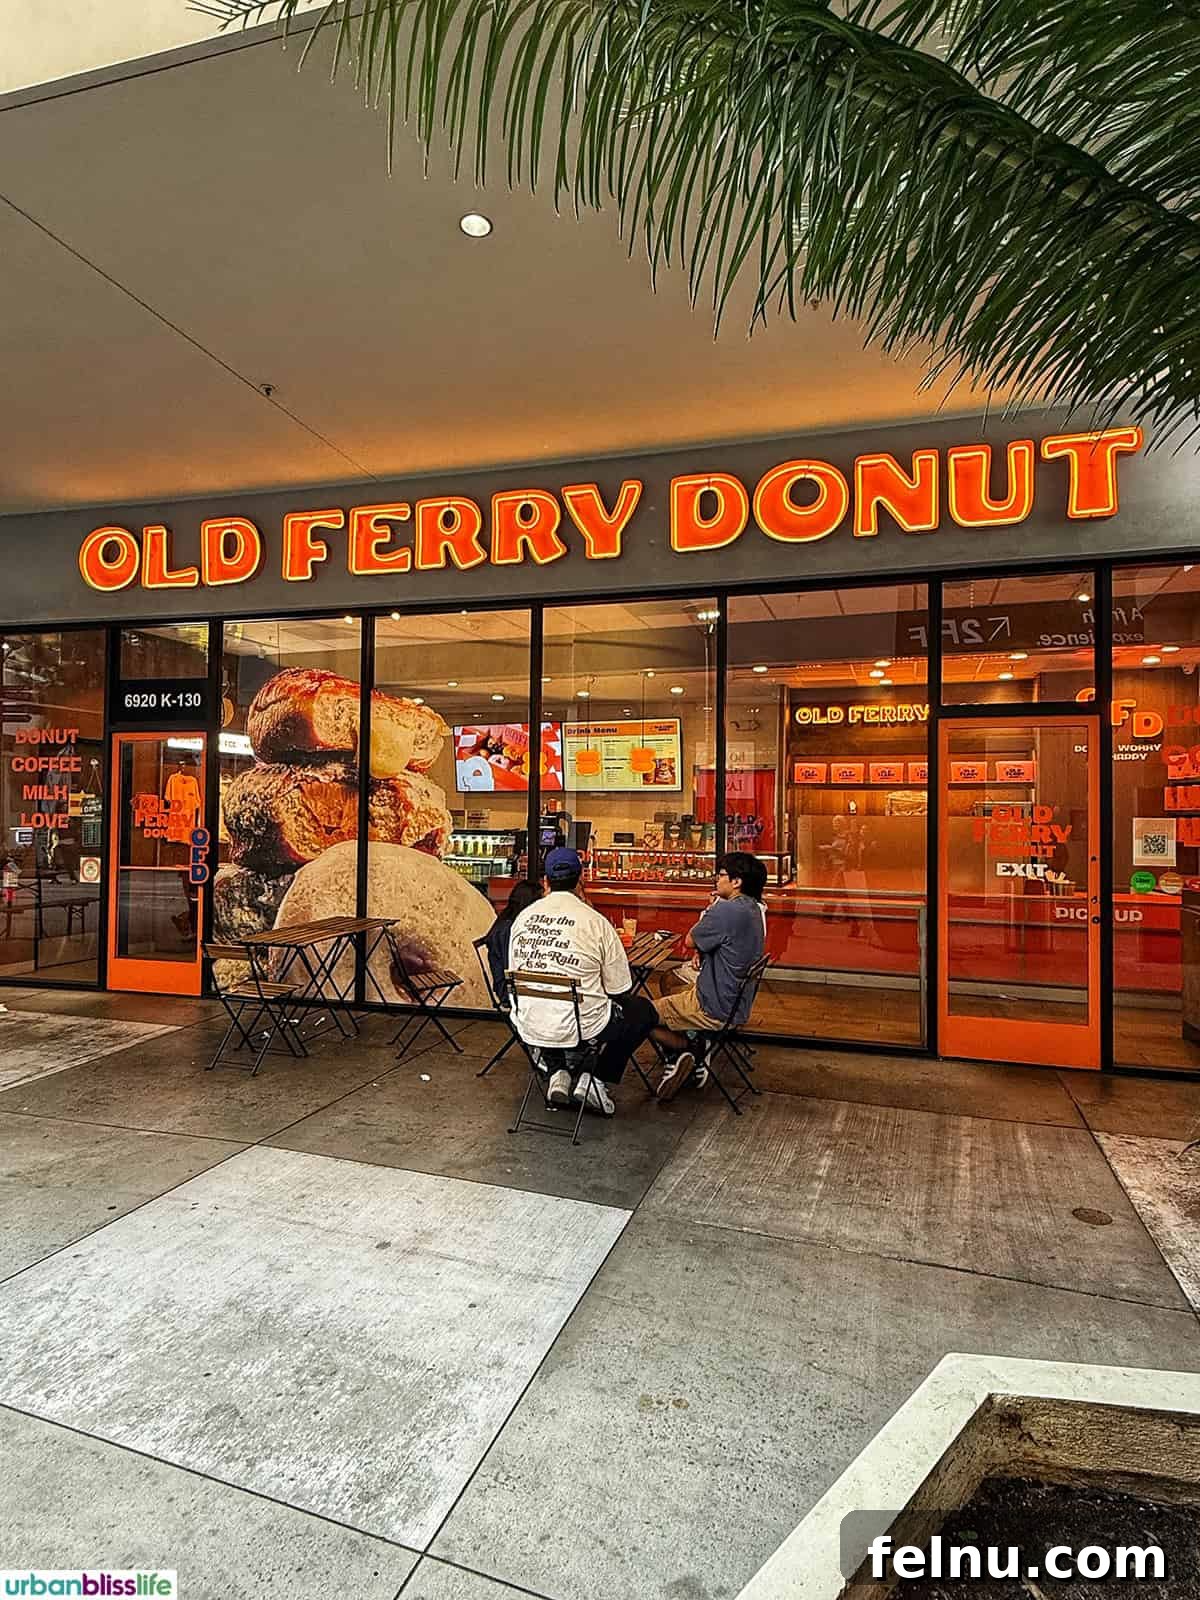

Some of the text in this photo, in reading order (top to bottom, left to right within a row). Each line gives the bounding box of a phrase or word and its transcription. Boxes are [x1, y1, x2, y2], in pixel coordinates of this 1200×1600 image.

[79, 427, 1143, 592] OLD FERRY DONUT
[124, 692, 202, 708] 6920 K-130
[795, 703, 930, 725] OLD FERRY
[15, 728, 79, 744] DONUT
[567, 727, 592, 735] Drink
[11, 756, 82, 773] COFFEE
[21, 812, 71, 829] LOVE
[190, 827, 210, 884] OFD
[996, 861, 1049, 877] EXIT
[556, 915, 576, 927] the
[1055, 906, 1144, 922] PIC UP
